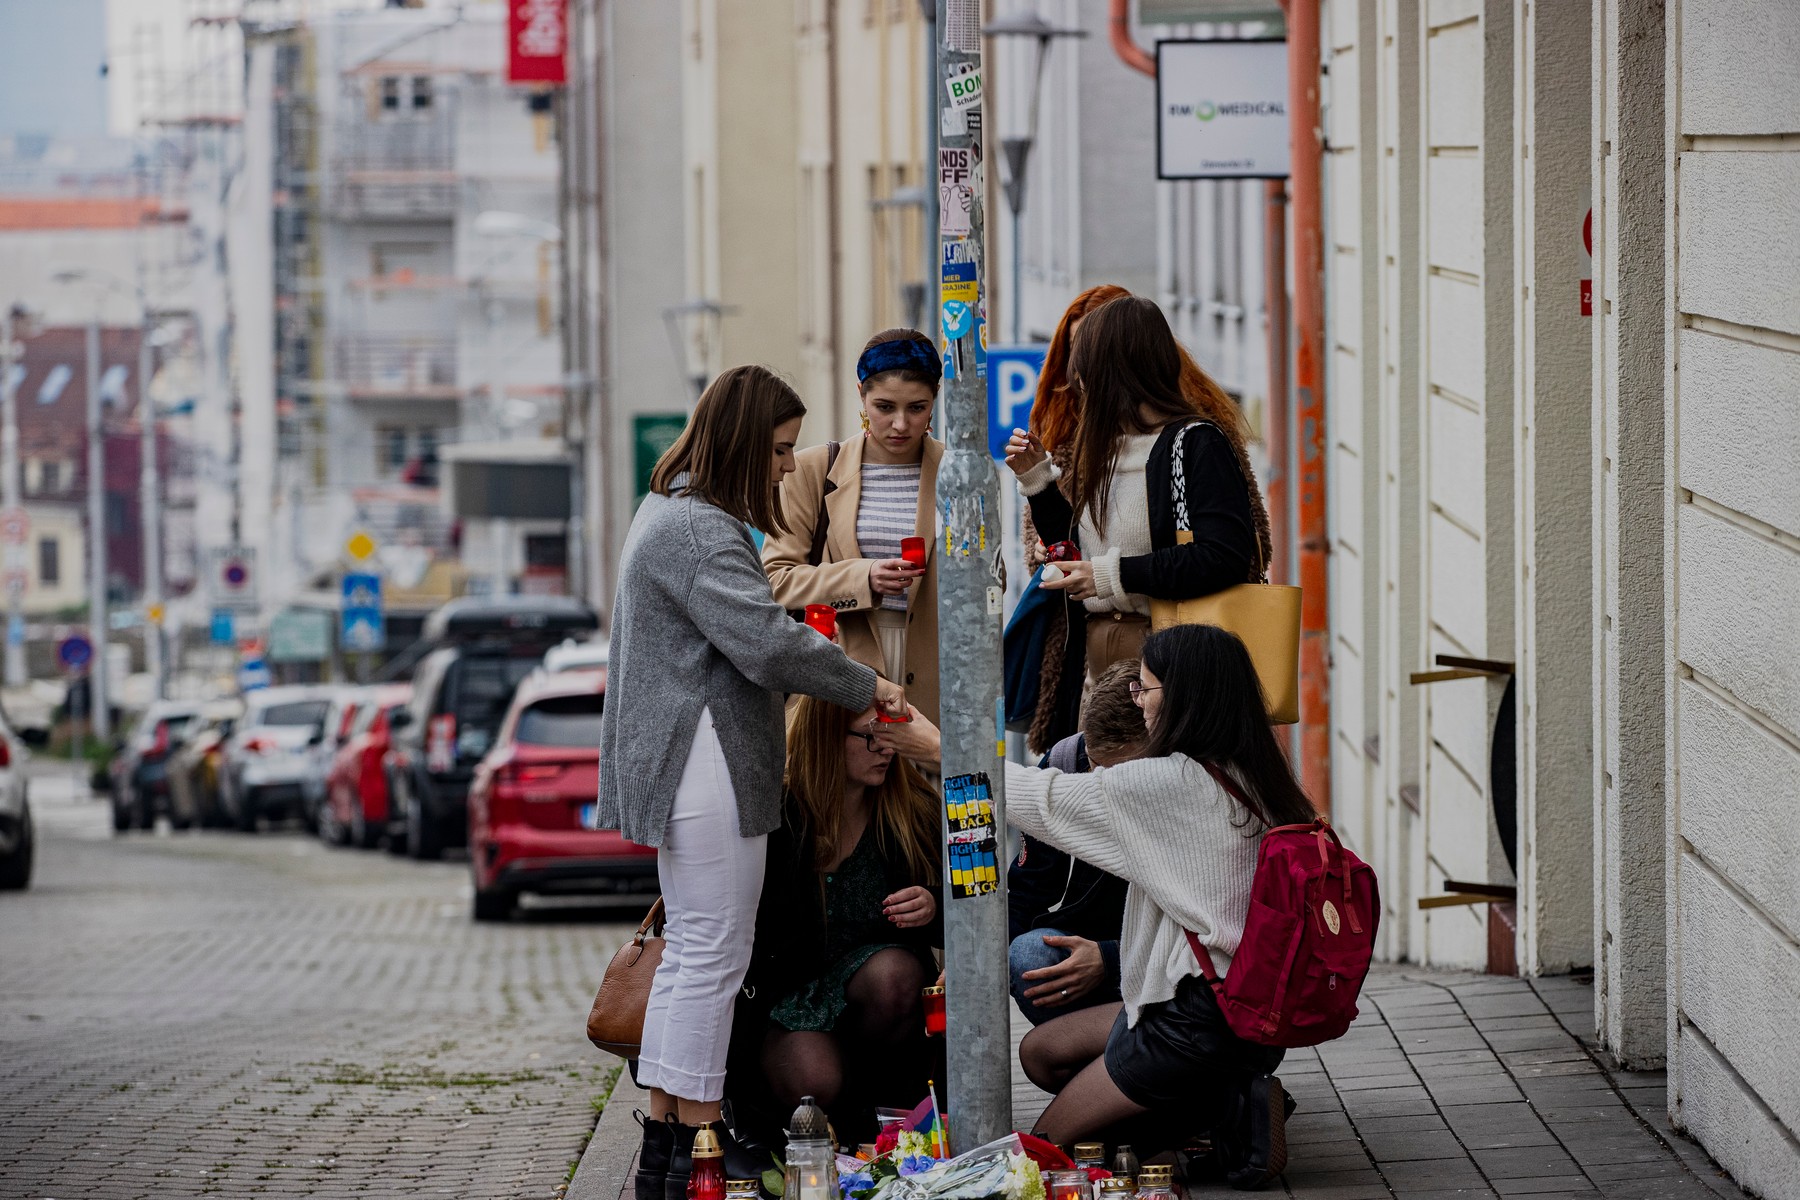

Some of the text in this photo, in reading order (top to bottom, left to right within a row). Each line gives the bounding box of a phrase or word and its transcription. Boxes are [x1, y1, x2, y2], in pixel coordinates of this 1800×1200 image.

[1217, 103, 1285, 117] MEDICAL
[940, 169, 968, 183] FF
[997, 360, 1036, 429] P
[945, 776, 971, 790] FIGHT
[959, 814, 992, 830] BACK
[950, 842, 979, 856] FIGHT
[965, 881, 998, 896] BACK
